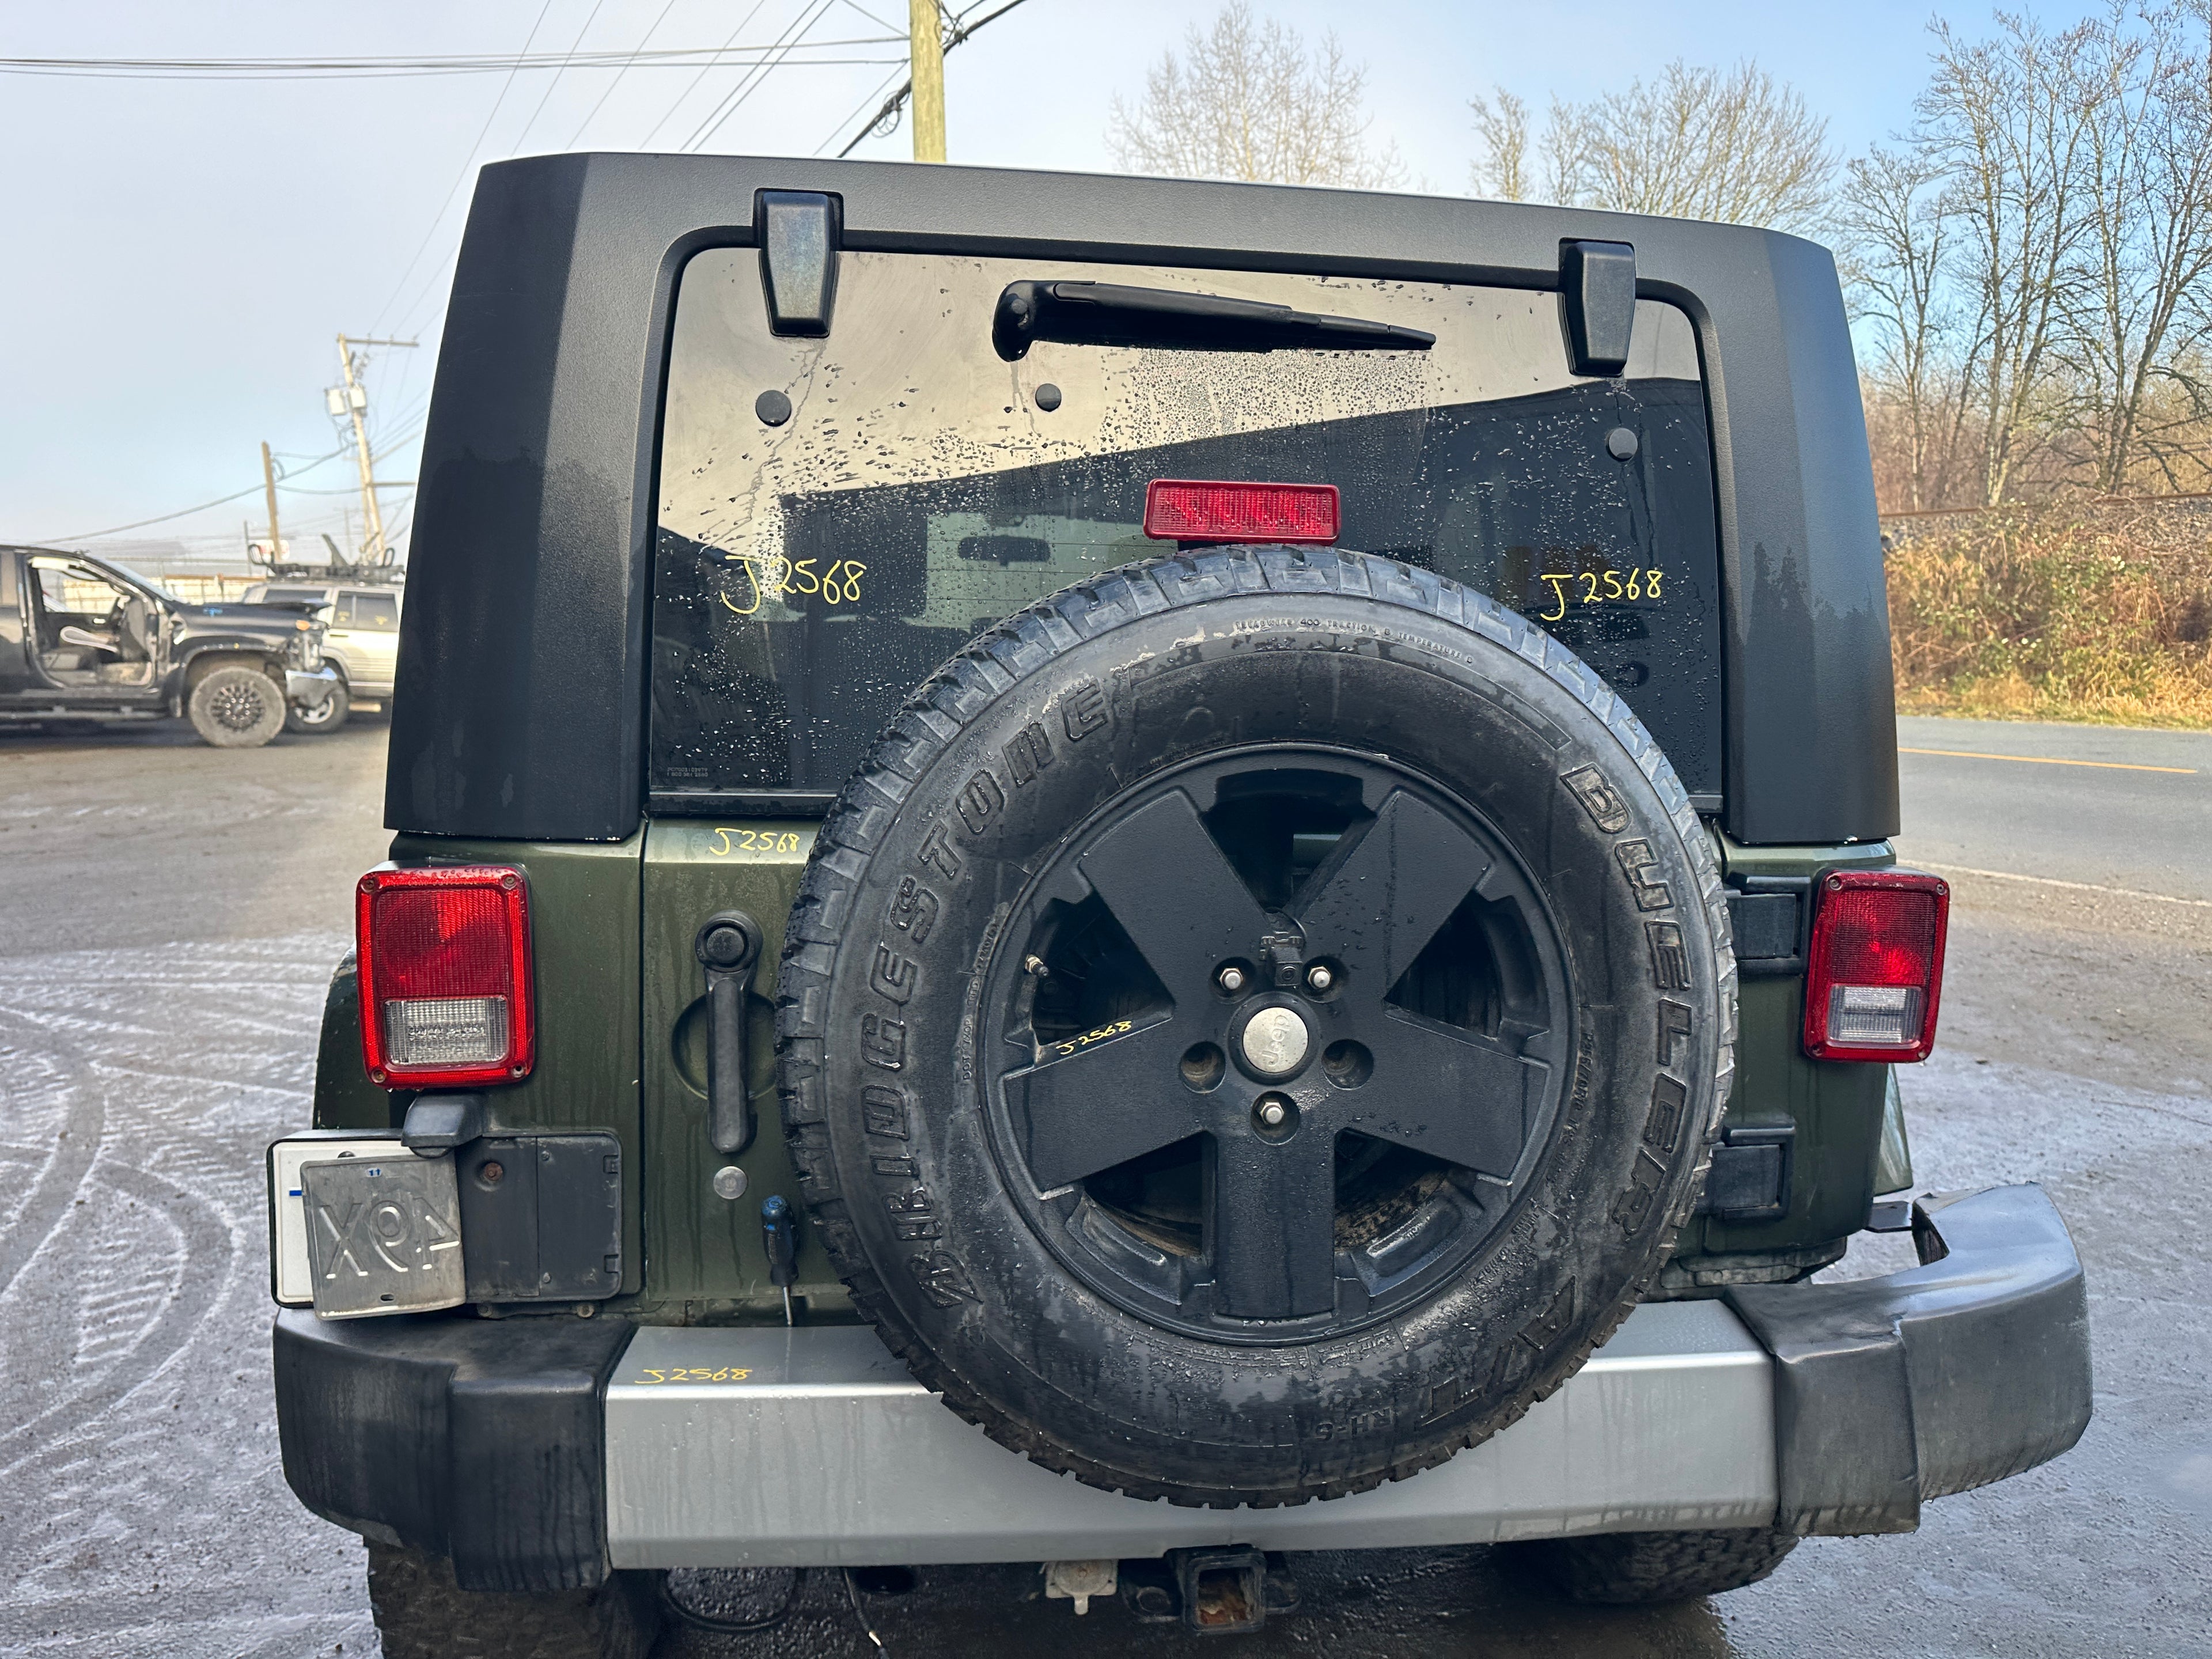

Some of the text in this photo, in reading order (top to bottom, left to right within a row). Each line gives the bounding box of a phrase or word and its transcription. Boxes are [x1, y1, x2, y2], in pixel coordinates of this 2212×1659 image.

[1300, 618, 1321, 627] 400
[1328, 620, 1376, 633] TRACTION
[1398, 632, 1462, 659] TEMPERATURE
[860, 677, 1109, 1309] BRIDGESTONE
[1560, 761, 1692, 1236] DUELER
[1262, 1014, 1291, 1066] Jeep
[962, 1055, 972, 1081] DOT
